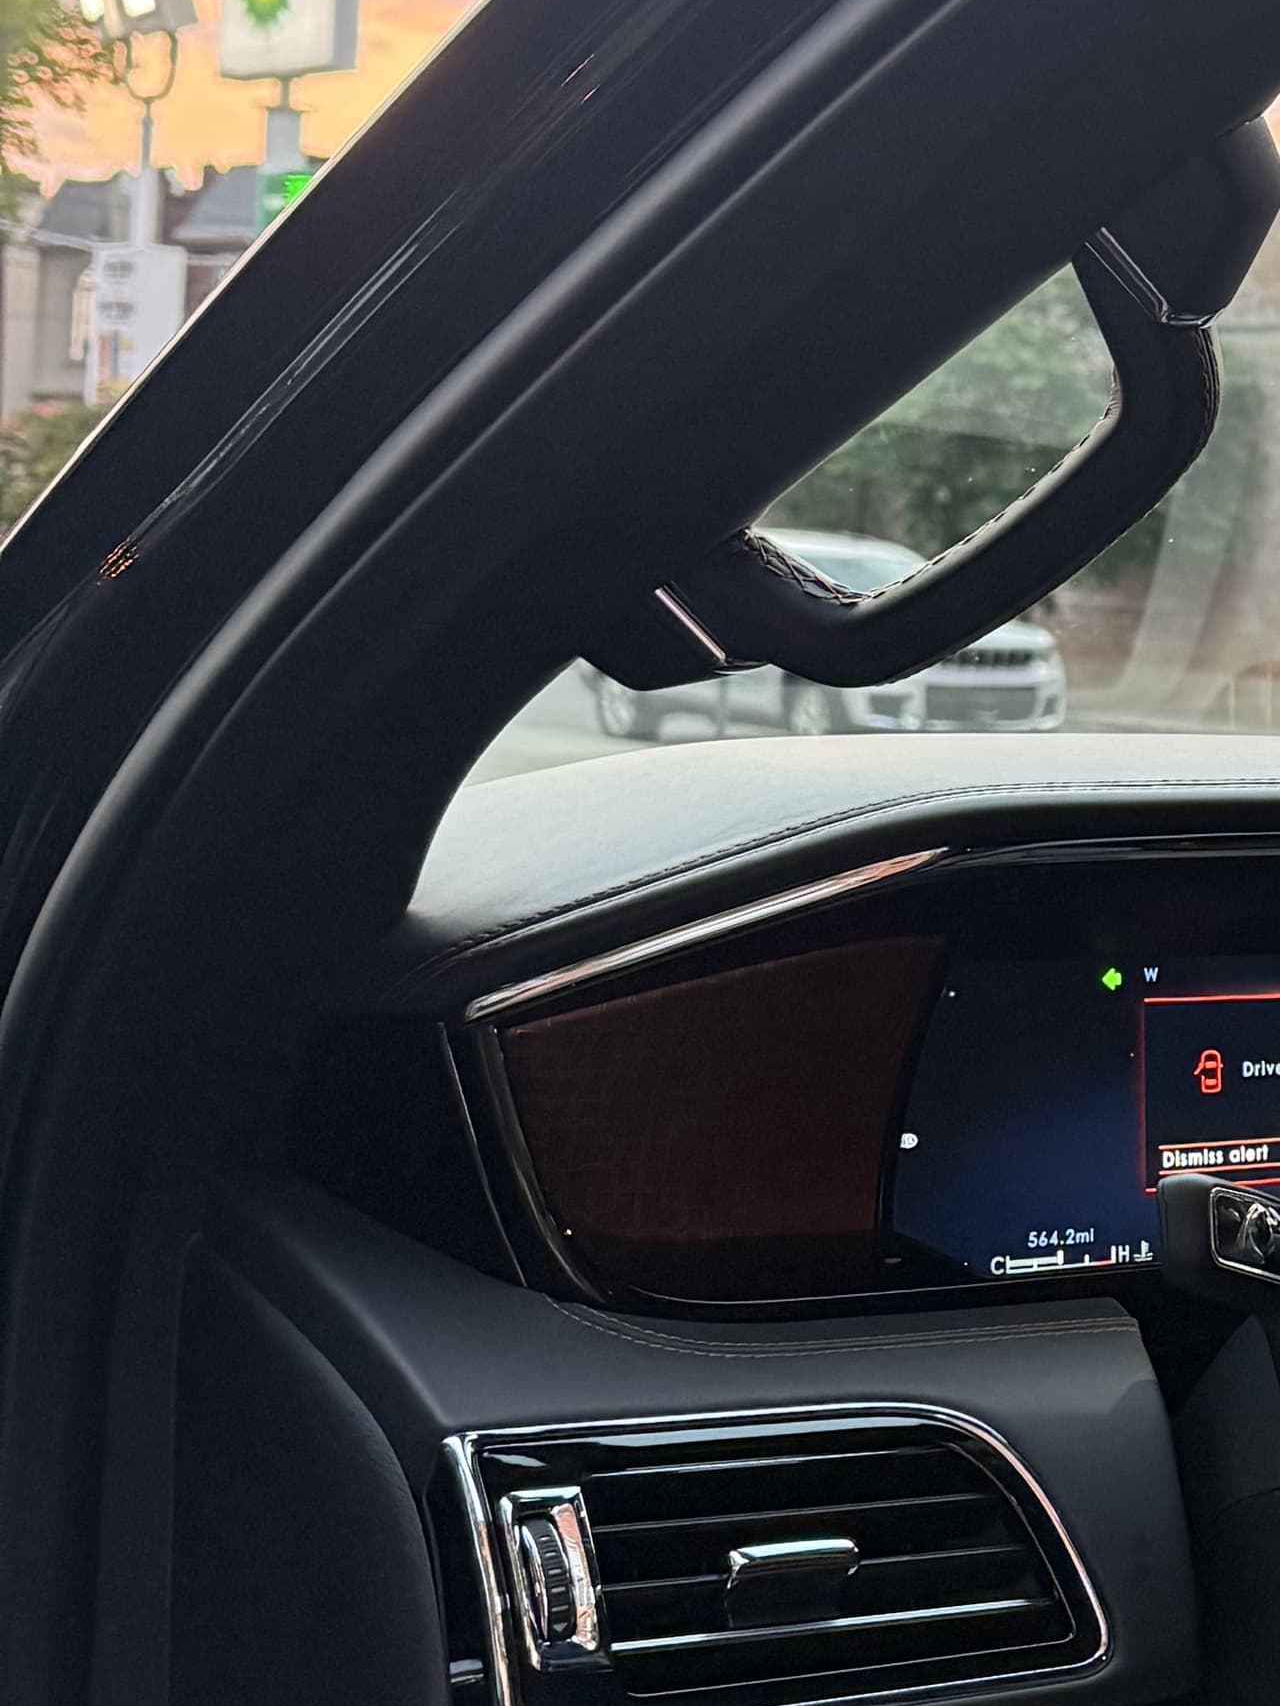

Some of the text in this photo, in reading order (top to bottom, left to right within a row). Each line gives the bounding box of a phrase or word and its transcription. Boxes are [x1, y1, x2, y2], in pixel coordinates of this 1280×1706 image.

[1143, 966, 1159, 983] W
[1162, 1144, 1270, 1169] Dismiss alert
[1027, 1227, 1095, 1248] 564.2mi
[990, 1255, 1005, 1276] C
